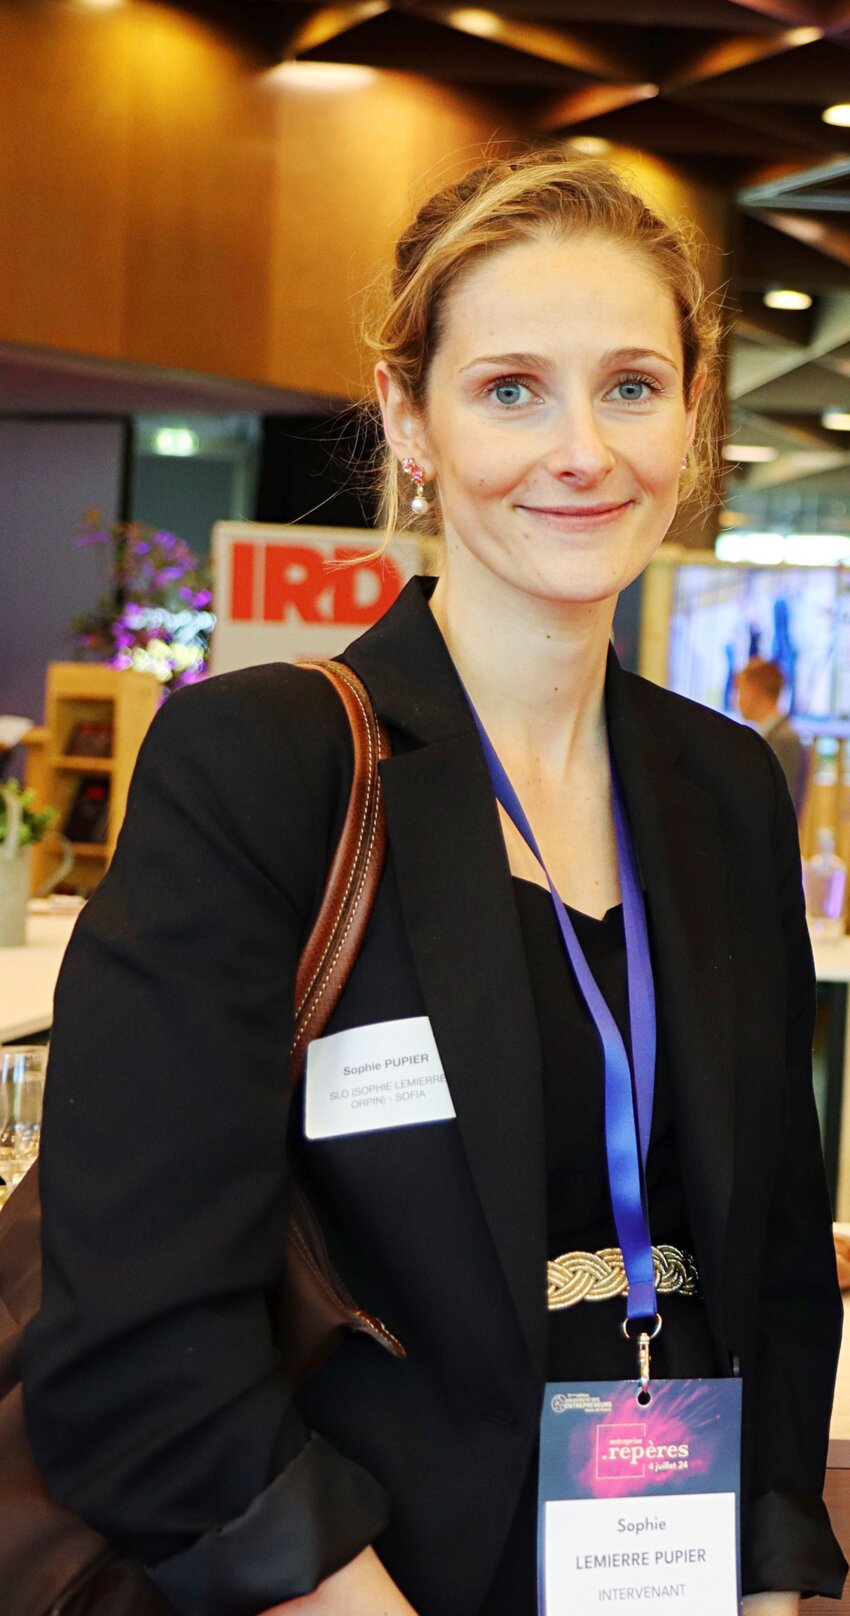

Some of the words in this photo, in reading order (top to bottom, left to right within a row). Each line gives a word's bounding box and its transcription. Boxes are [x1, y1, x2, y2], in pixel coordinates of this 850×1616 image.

[231, 542, 404, 624] IRD
[343, 1061, 382, 1076] Sophie
[385, 1053, 429, 1068] PUPIER
[329, 1090, 350, 1101] SLO
[351, 1083, 392, 1098] (SOPHIE
[394, 1073, 447, 1089] LEMIERRE
[351, 1095, 386, 1110] ORPIN)
[395, 1089, 427, 1102] SOFIA
[602, 1440, 689, 1465] .repères
[649, 1462, 654, 1470] 4
[655, 1461, 676, 1472] juillet
[678, 1460, 688, 1469] 24
[617, 1516, 667, 1535] Sophie
[576, 1552, 650, 1570] LEMIERRE
[655, 1548, 707, 1565] PUPIER
[598, 1584, 686, 1602] INTERVENANT
